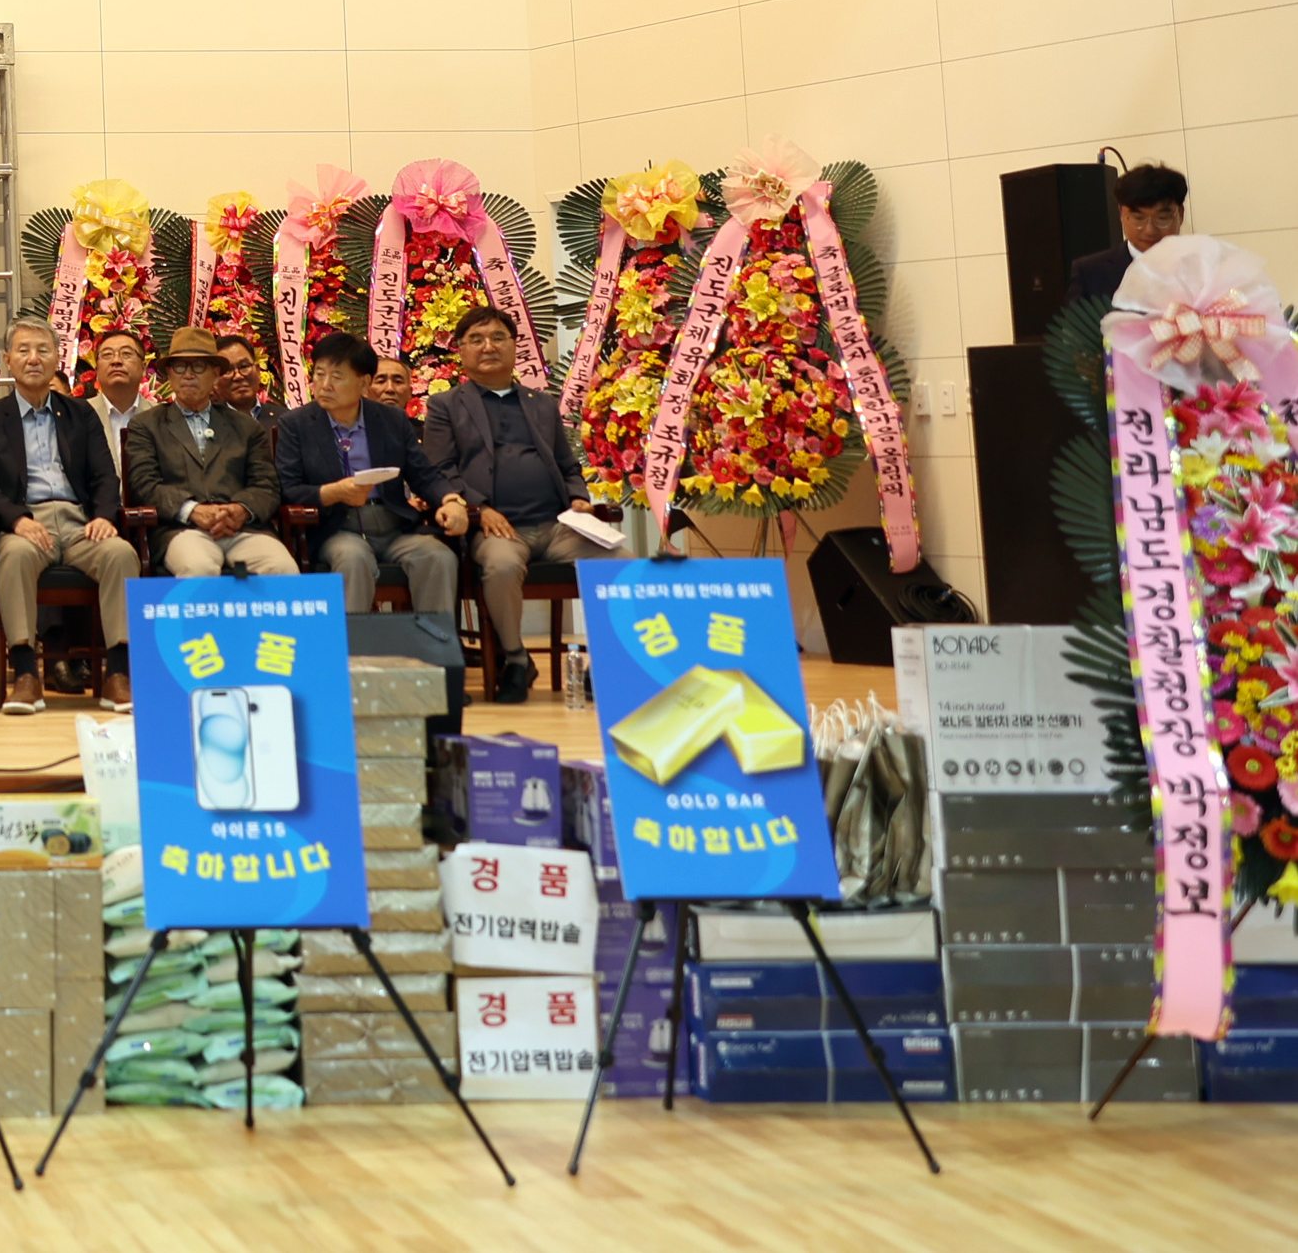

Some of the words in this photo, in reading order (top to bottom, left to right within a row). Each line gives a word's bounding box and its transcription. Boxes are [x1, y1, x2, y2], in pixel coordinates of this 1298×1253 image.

[483, 257, 508, 273] 축
[815, 245, 840, 261] 축
[821, 265, 851, 312] 글로벌
[663, 254, 733, 416] 진도군체육회장
[835, 315, 872, 363] 근로자
[646, 423, 682, 492] 조규철
[879, 446, 905, 498] 올림픽
[932, 634, 1003, 656] BONADE
[1119, 406, 1197, 759] 전라남도경찰청장
[1165, 773, 1218, 919] 박정보
[666, 793, 720, 810] GOLD
[726, 792, 766, 809] BAR
[632, 814, 800, 855] 축하합니다
[160, 841, 332, 883] 축하합니다
[452, 911, 582, 945] 전기압력밥솥
[466, 1047, 599, 1076] 전기압력밥솥
